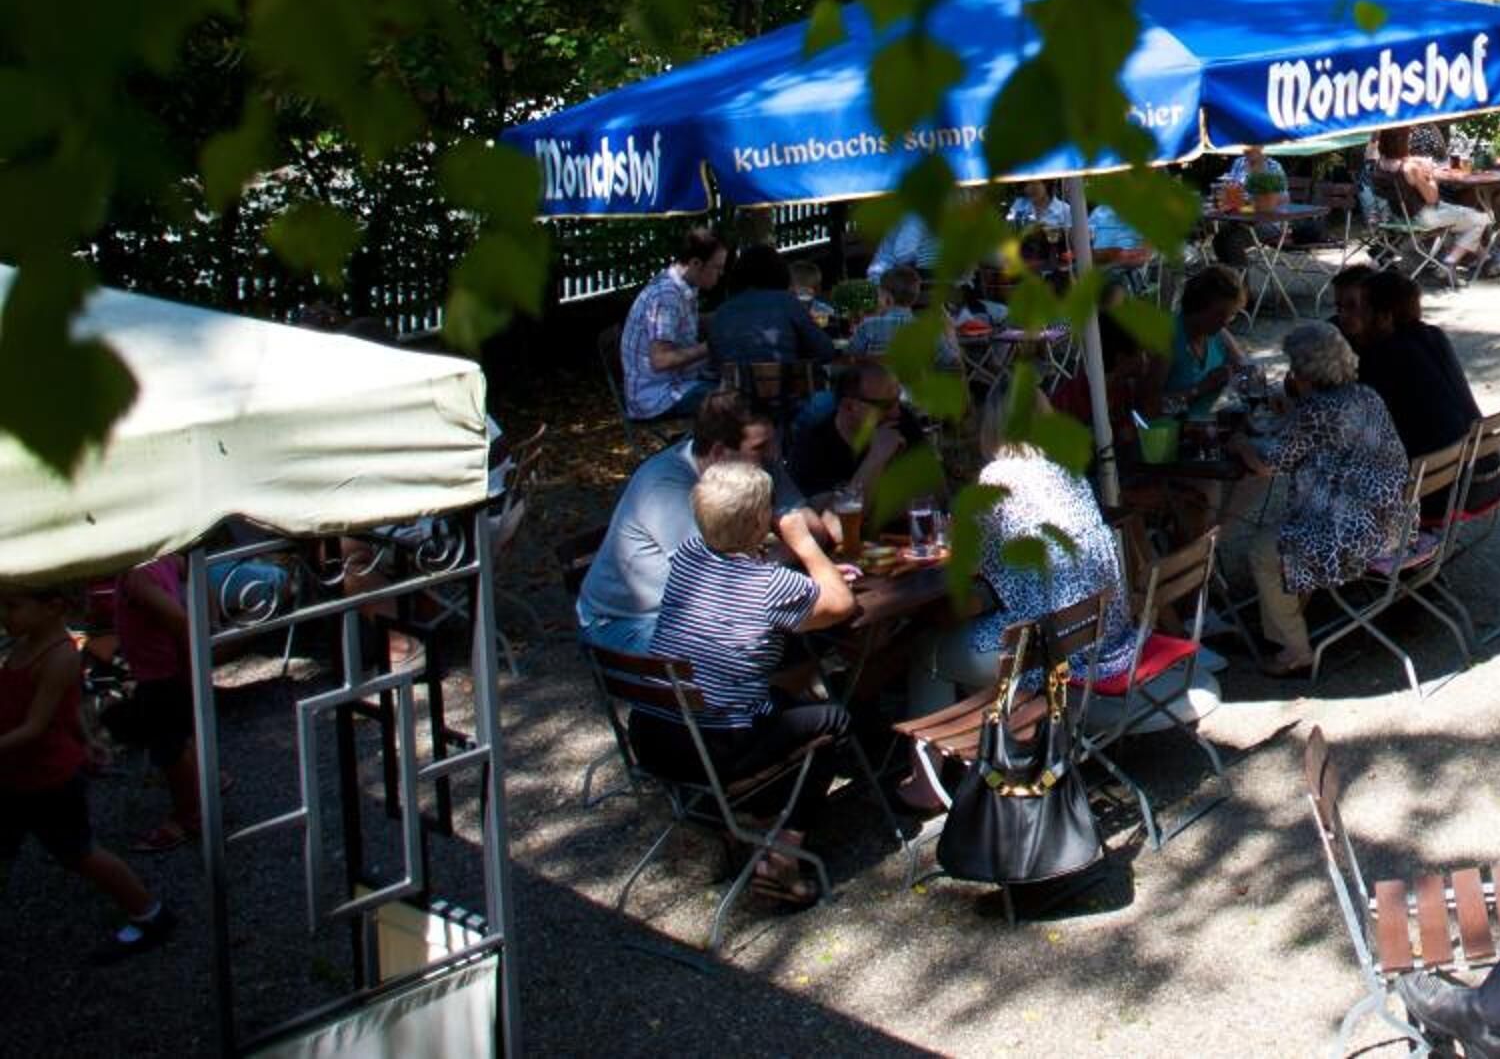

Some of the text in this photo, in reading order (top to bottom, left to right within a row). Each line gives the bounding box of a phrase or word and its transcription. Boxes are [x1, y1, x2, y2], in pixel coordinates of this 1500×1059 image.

[1267, 32, 1489, 130] Mönchshof
[534, 130, 661, 206] Mönchshof
[733, 131, 890, 173] Kulmbachs
